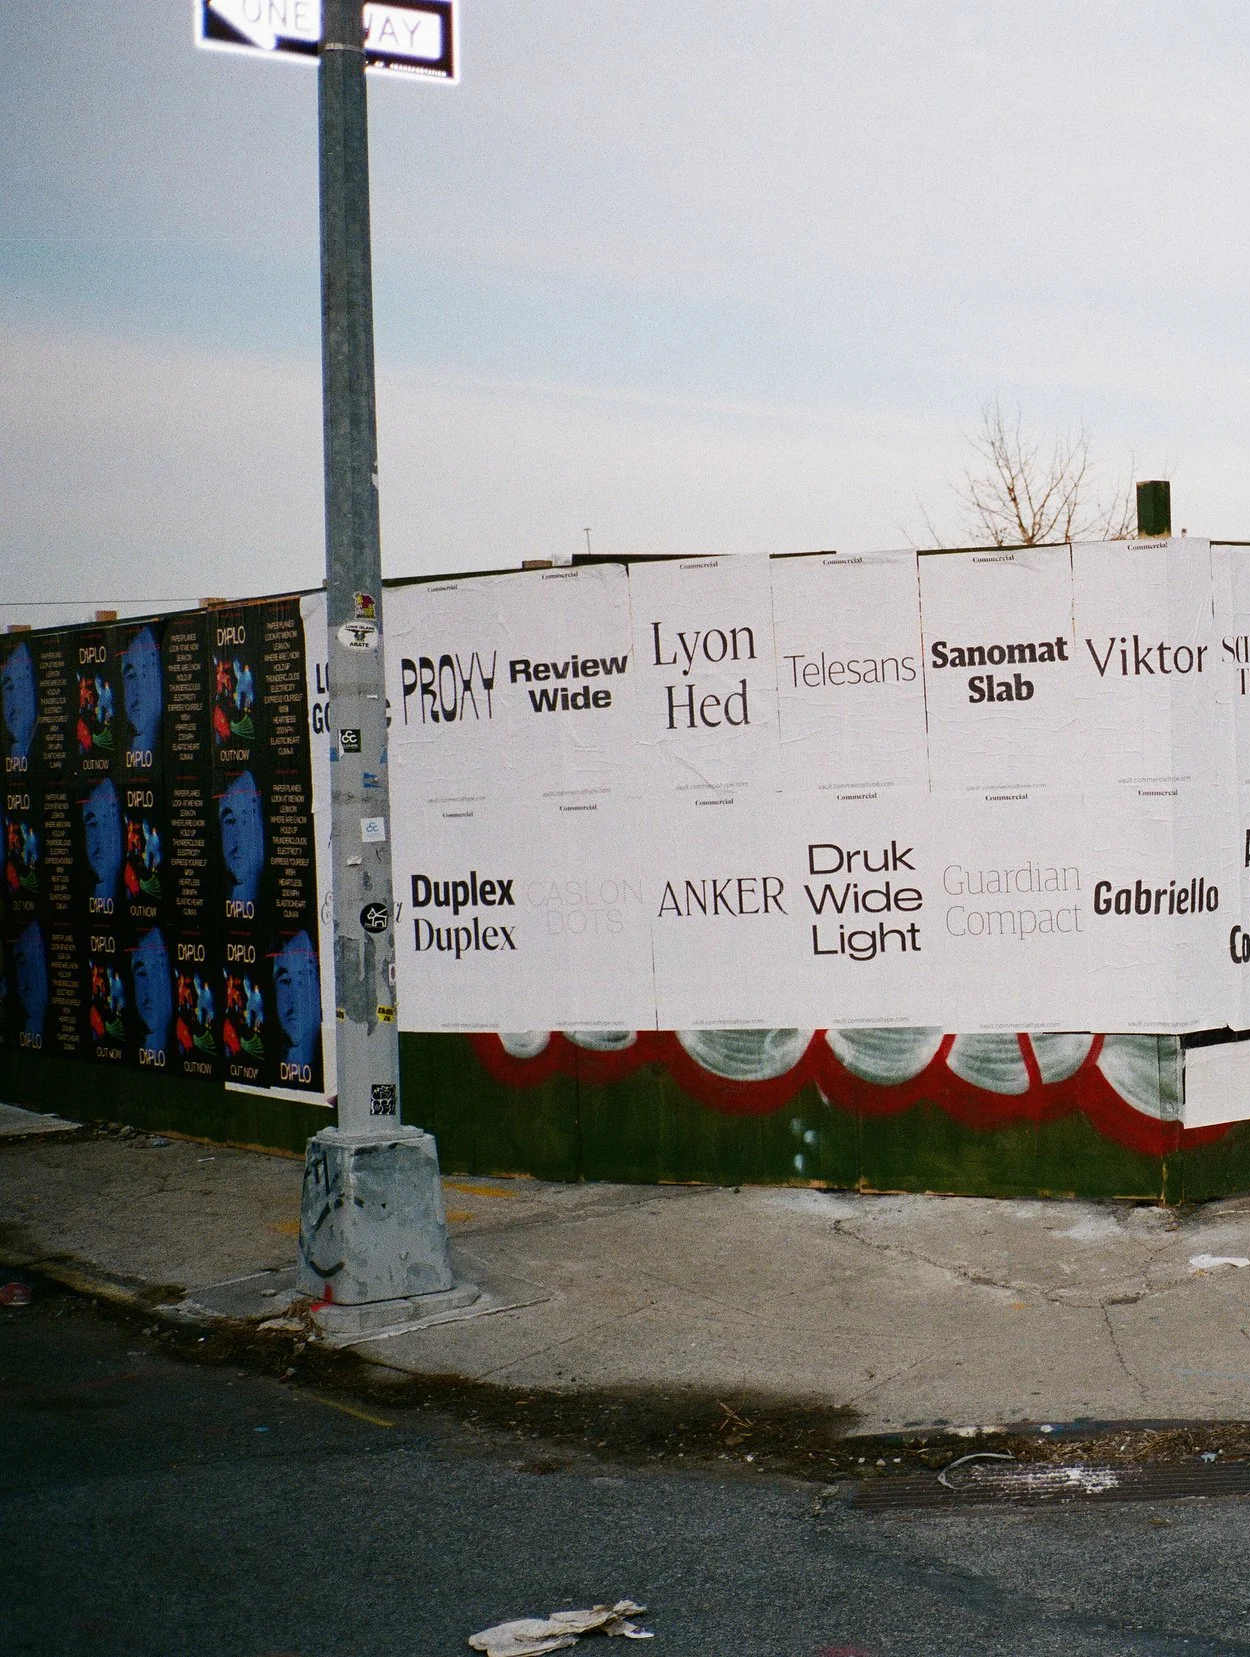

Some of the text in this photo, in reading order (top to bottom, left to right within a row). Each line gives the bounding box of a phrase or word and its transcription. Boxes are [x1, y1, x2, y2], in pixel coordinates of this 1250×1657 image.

[243, 0, 311, 32] ONE
[217, 626, 246, 646] DIPLO
[651, 622, 757, 675] Lyon
[79, 646, 106, 665] DIPLO
[931, 636, 1068, 669] Sanomat
[1085, 634, 1208, 677] Viktor
[509, 655, 628, 683] Review
[784, 652, 916, 688] Telesans
[401, 650, 497, 725] PROXY
[528, 686, 612, 712] Wide
[968, 673, 1035, 703] Slab
[665, 679, 750, 729] Hed
[6, 757, 28, 772] DIPLO
[126, 750, 152, 768] DIPLO
[7, 795, 30, 810] DIPLO
[127, 790, 153, 808] DIPLO
[695, 797, 733, 806] Commercial
[836, 792, 877, 801] Commercial
[808, 840, 915, 875] Druk
[943, 861, 1081, 896] Guardian
[89, 898, 114, 915] DIPLO
[411, 871, 515, 916] Duplex
[657, 874, 788, 918] ANKER
[804, 881, 923, 915] Wide
[1093, 877, 1219, 916] Gabriello
[226, 900, 254, 919] DIPLO
[946, 903, 1084, 940] Compact
[90, 936, 116, 953] DIPLO
[178, 943, 205, 962] DIPLO
[413, 918, 518, 959] Duplex
[812, 922, 921, 961] Light
[227, 943, 256, 964] DIPLO
[20, 1032, 42, 1049] DIPLO
[139, 1048, 165, 1067] DIPLO
[280, 1062, 312, 1084] DIPLO
